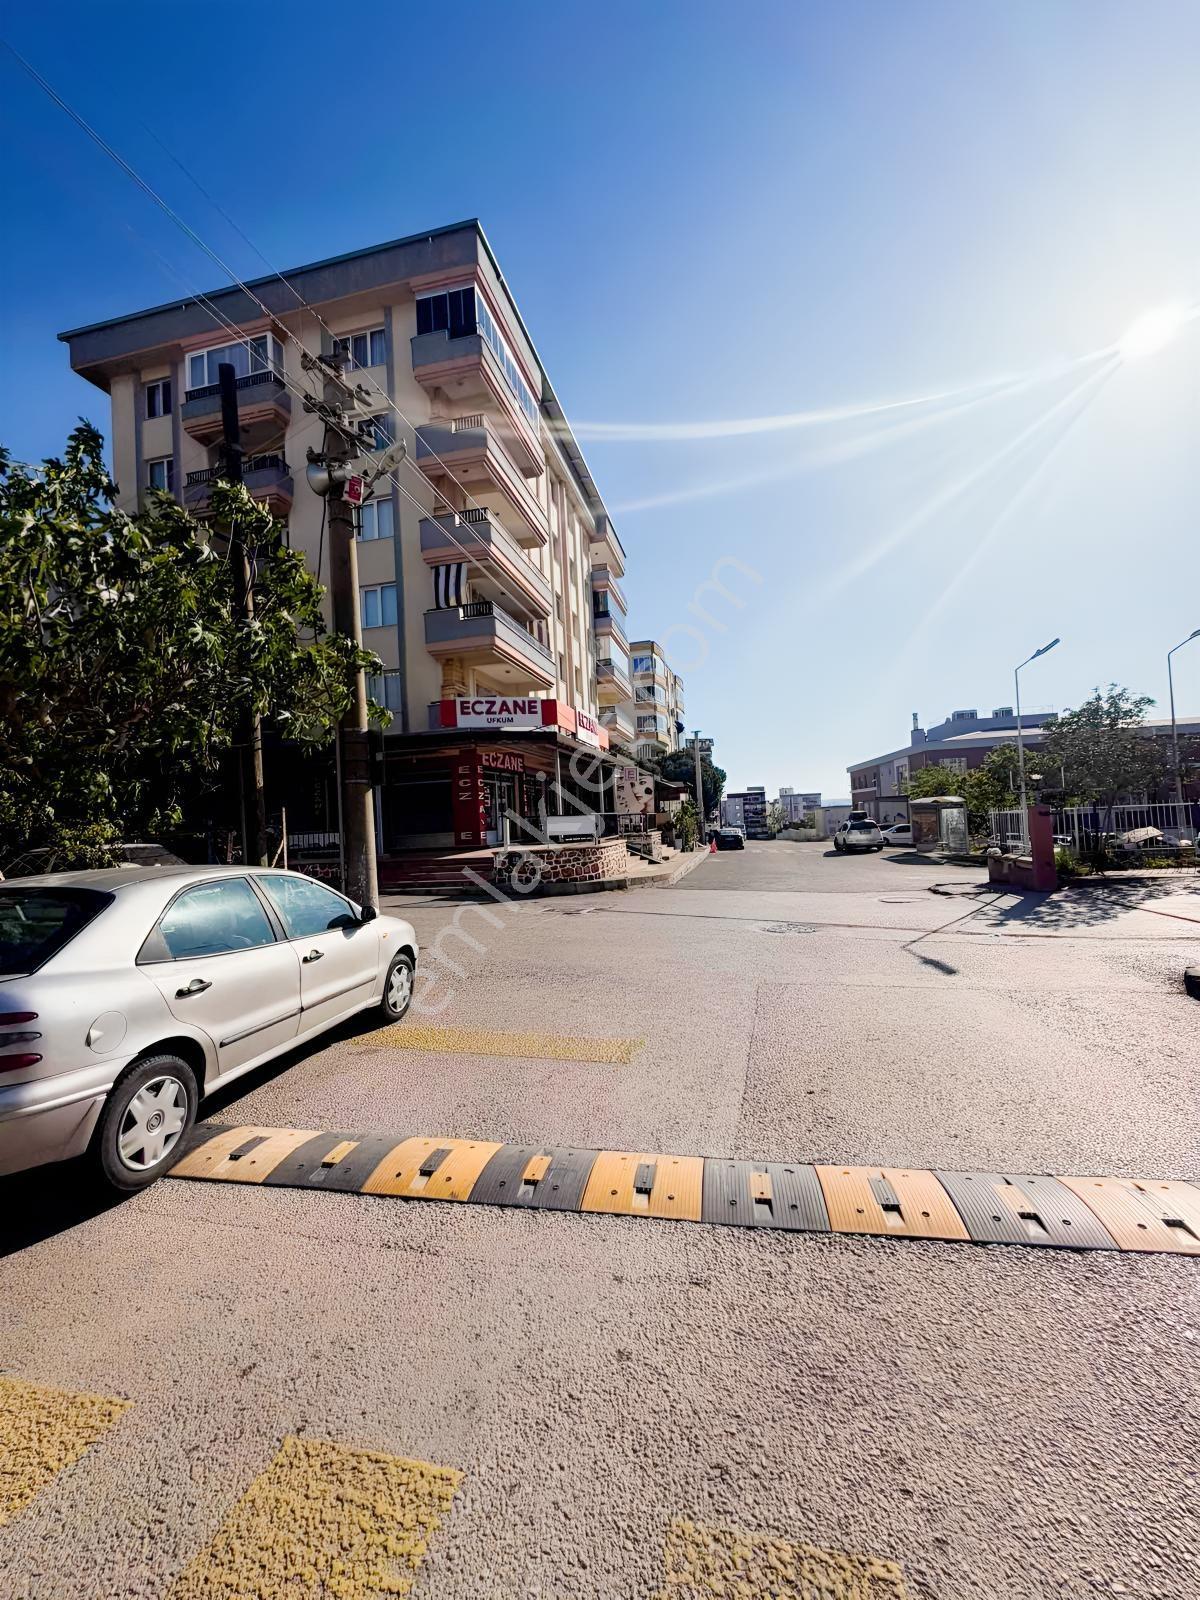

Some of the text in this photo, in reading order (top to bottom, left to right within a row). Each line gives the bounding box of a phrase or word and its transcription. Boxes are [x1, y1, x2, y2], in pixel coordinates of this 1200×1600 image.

[459, 699, 539, 716] ECZANE
[486, 716, 514, 724] UFKUM
[481, 751, 525, 773] ECZANE
[458, 765, 472, 840] ECZE
